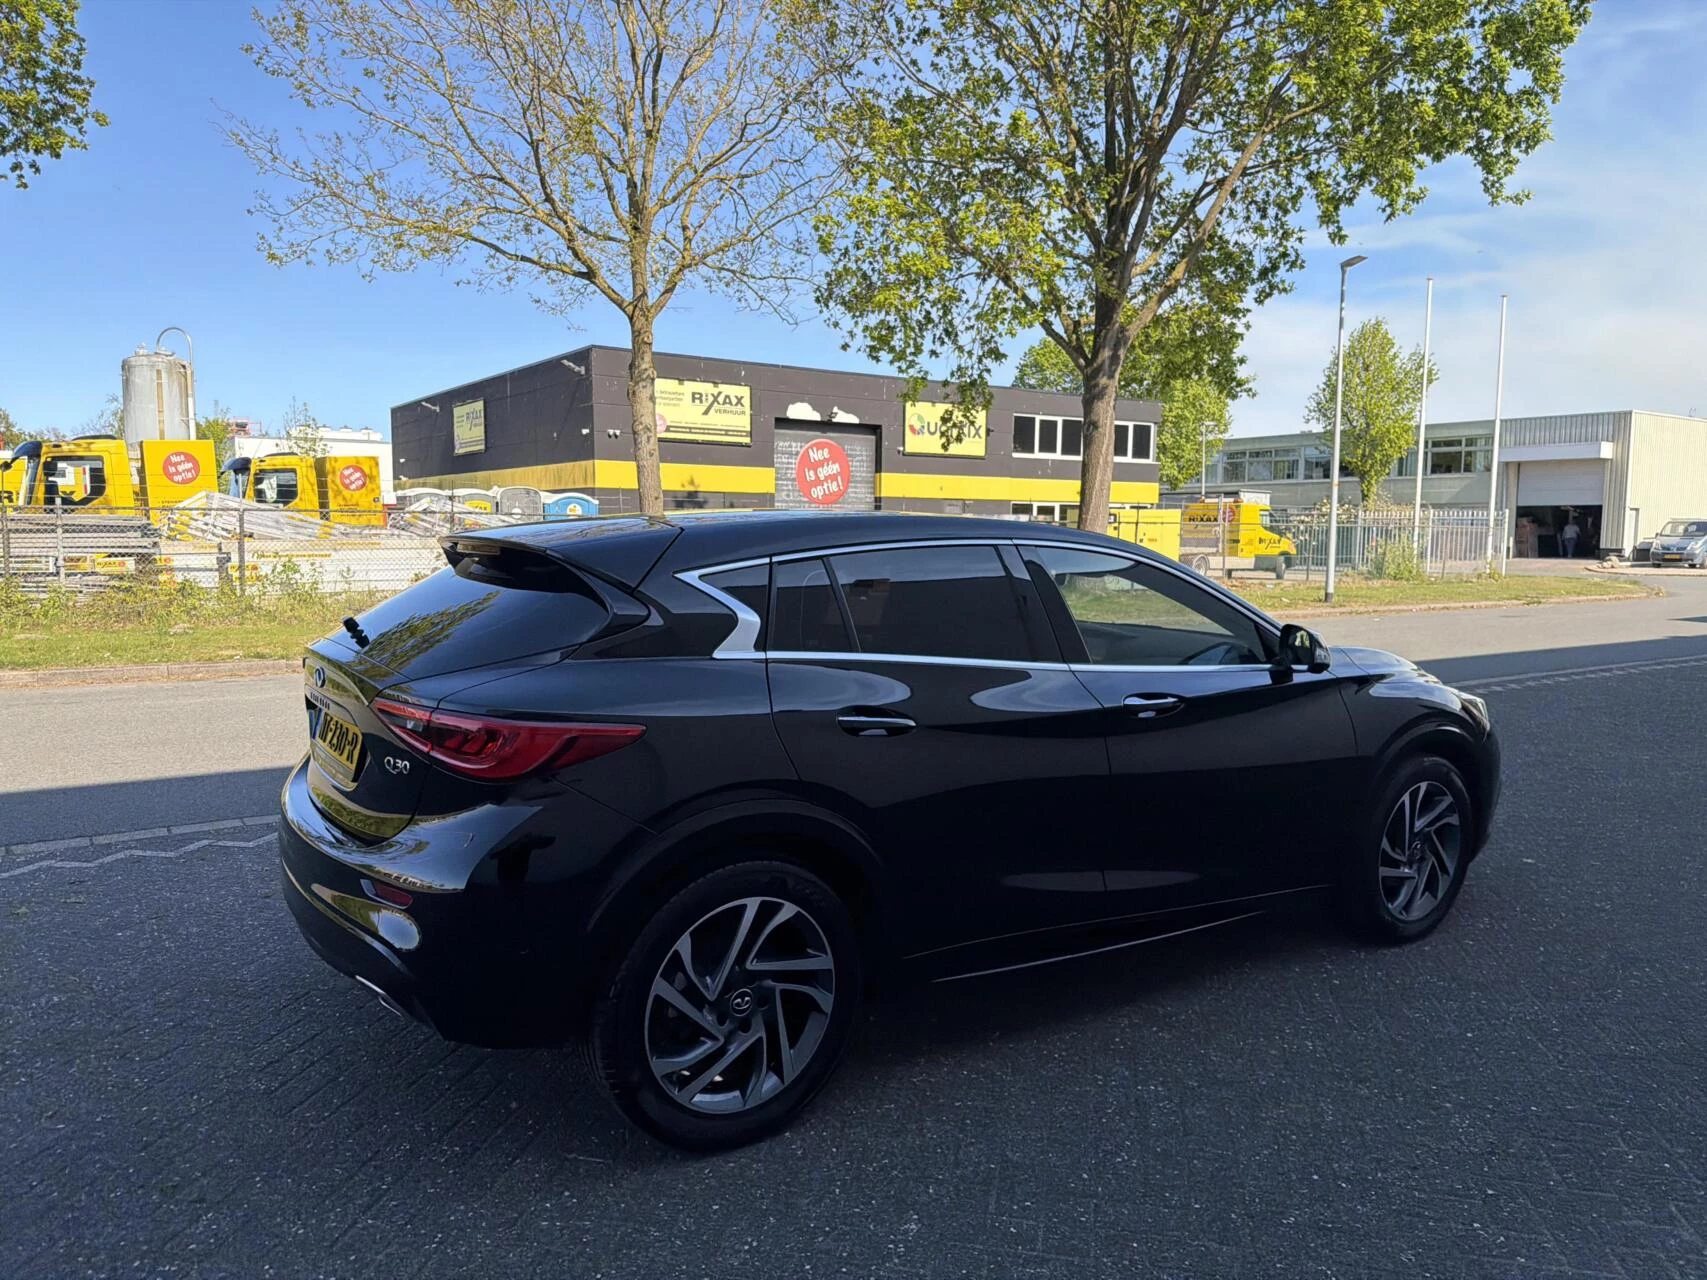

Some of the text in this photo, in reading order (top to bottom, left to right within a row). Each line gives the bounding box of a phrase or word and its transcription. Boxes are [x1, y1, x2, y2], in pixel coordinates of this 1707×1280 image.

[714, 408, 746, 416] VERHUUR
[808, 446, 830, 463] Nee
[816, 460, 841, 481] géén
[810, 475, 843, 500] optie!
[384, 756, 410, 775] Q30
